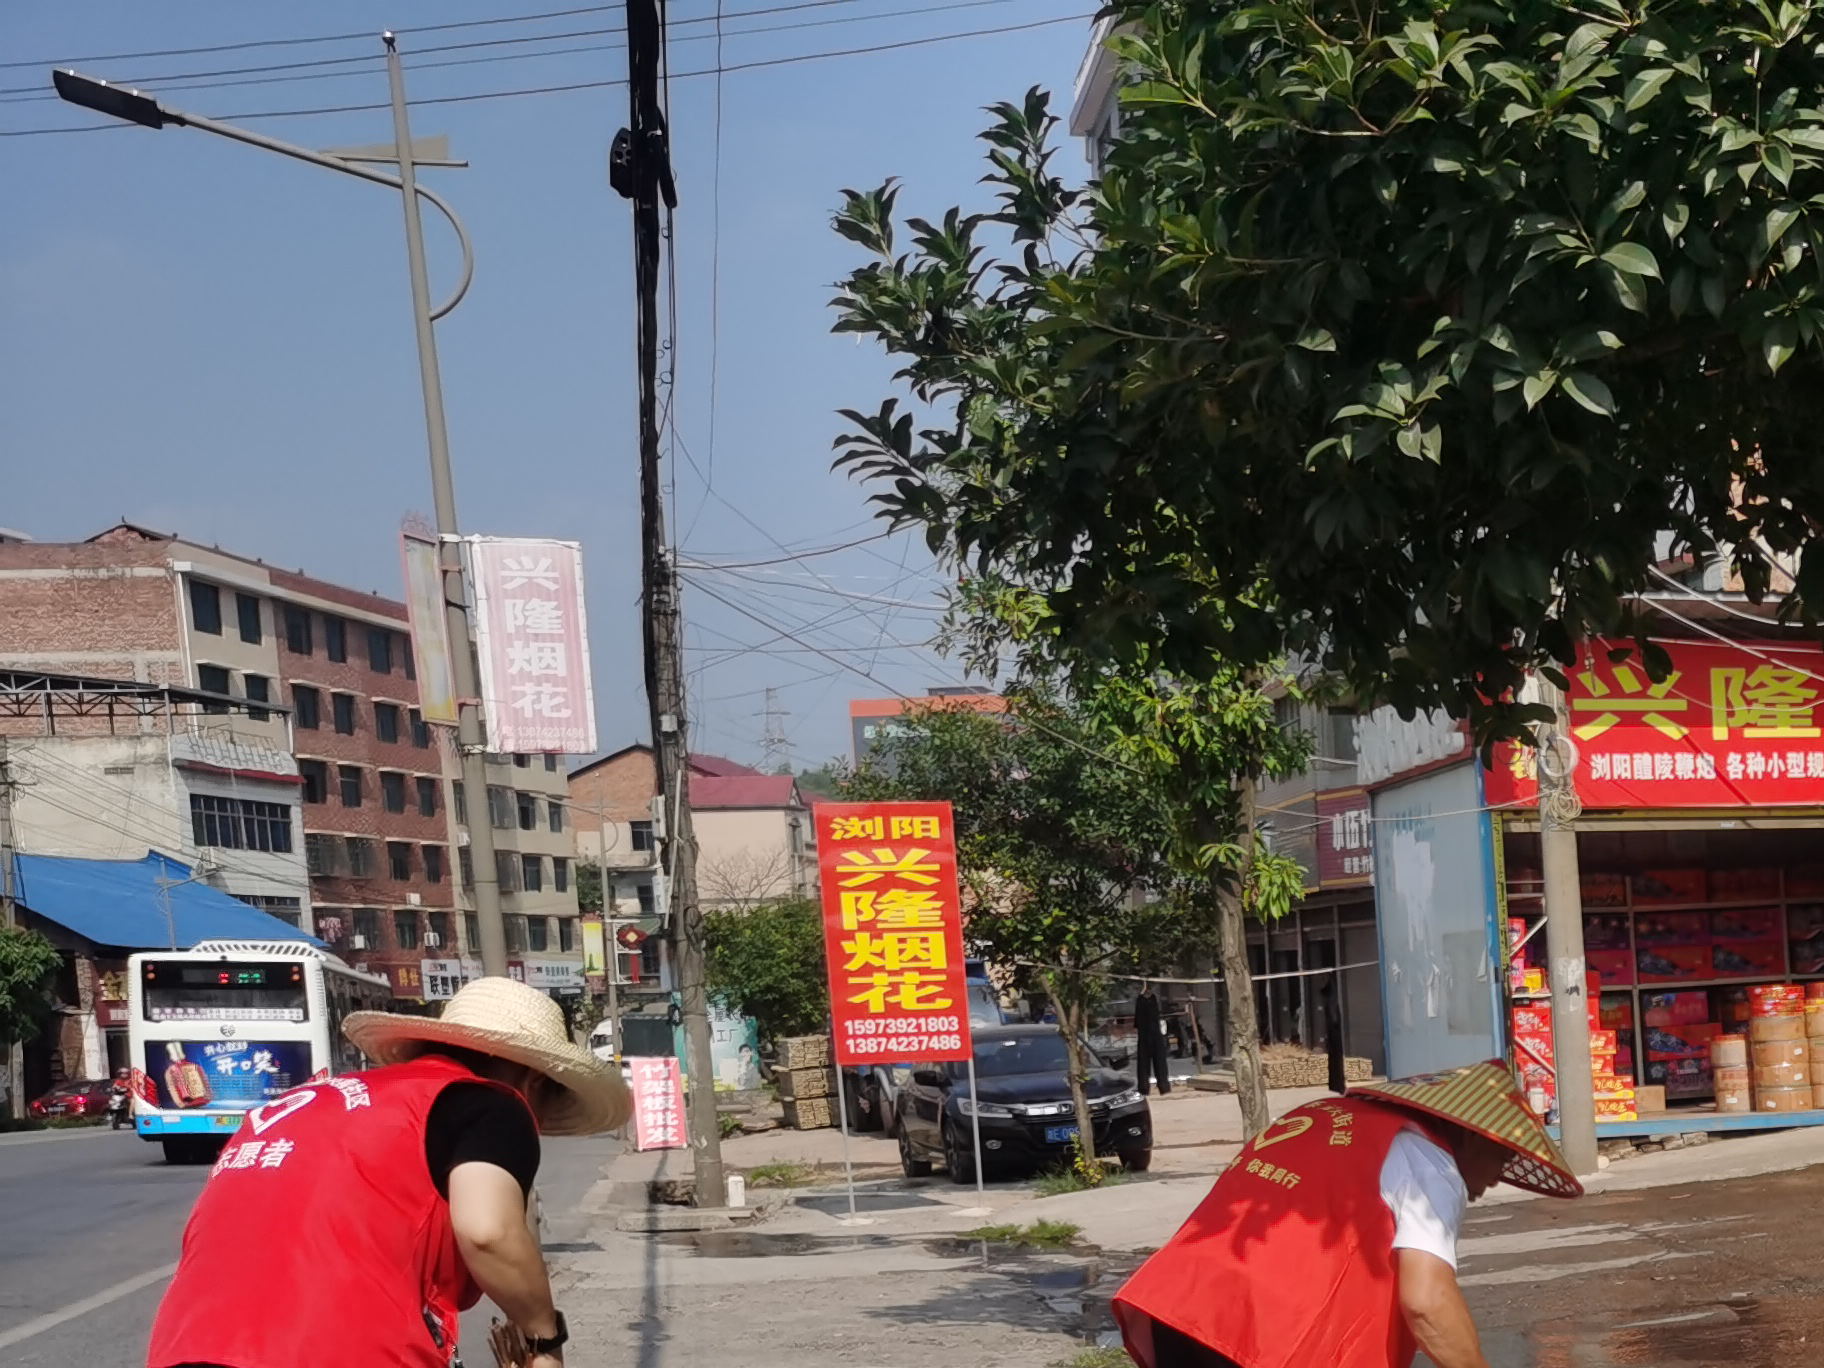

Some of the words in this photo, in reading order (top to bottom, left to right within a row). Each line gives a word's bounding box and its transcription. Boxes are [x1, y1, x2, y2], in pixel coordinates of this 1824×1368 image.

[500, 555, 573, 719] 兴隆烟花
[1590, 752, 1716, 781] 浏阳醴陵鞭炮
[829, 815, 941, 841] 浏阳
[834, 847, 953, 1014] 兴隆烟花
[843, 1015, 960, 1037] 15973921803
[845, 1034, 962, 1055] 13874237486
[639, 1063, 679, 1144] 竹架板批发
